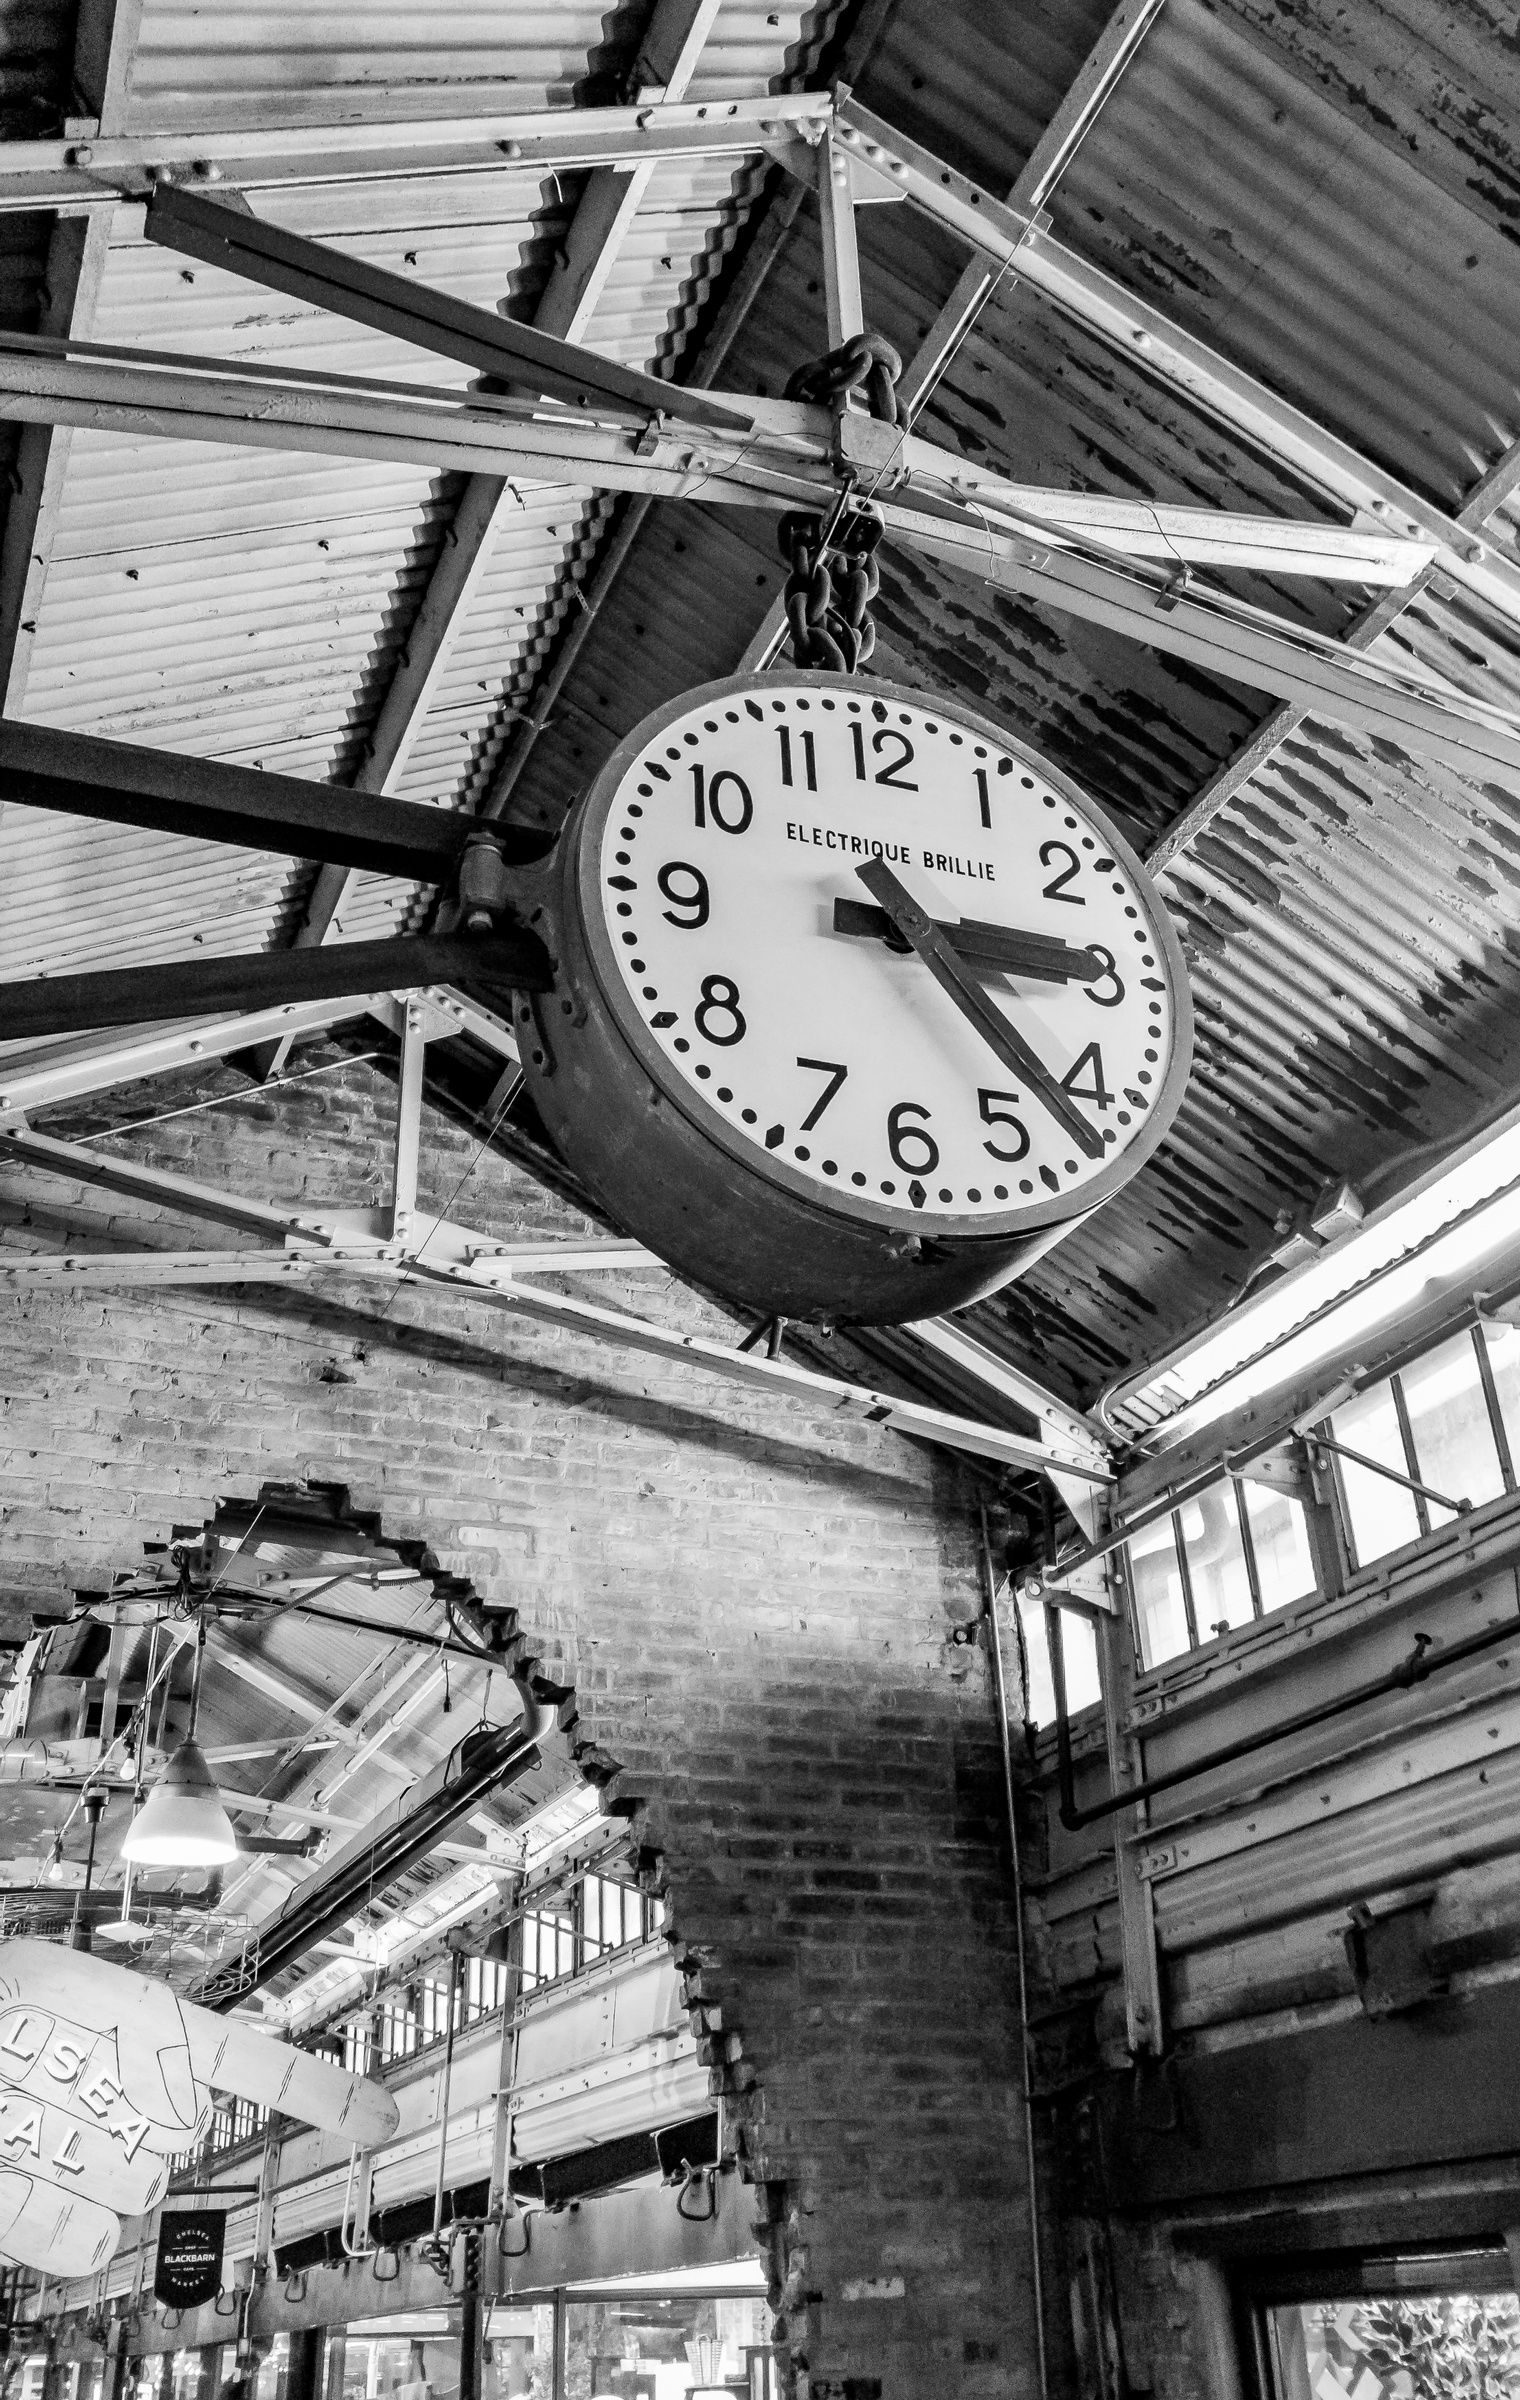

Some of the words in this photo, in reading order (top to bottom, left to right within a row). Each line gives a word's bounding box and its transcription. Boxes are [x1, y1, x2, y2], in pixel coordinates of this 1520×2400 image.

[774, 724, 818, 792] 11
[847, 722, 919, 792] 12
[687, 763, 753, 835] 10
[971, 768, 992, 829] 1
[786, 822, 911, 865] ELECTRIQUE
[923, 851, 996, 881] BRILLIE
[1038, 840, 1086, 906] 2
[657, 861, 710, 930] 9
[1081, 943, 1126, 1007] 3
[694, 974, 747, 1047] 8
[796, 1056, 848, 1132] 7
[1060, 1042, 1116, 1111] 4
[887, 1102, 940, 1177] 6
[977, 1087, 1031, 1163] 5
[0, 2103, 85, 2176] AL
[164, 2253, 215, 2263] BLACKBARN
